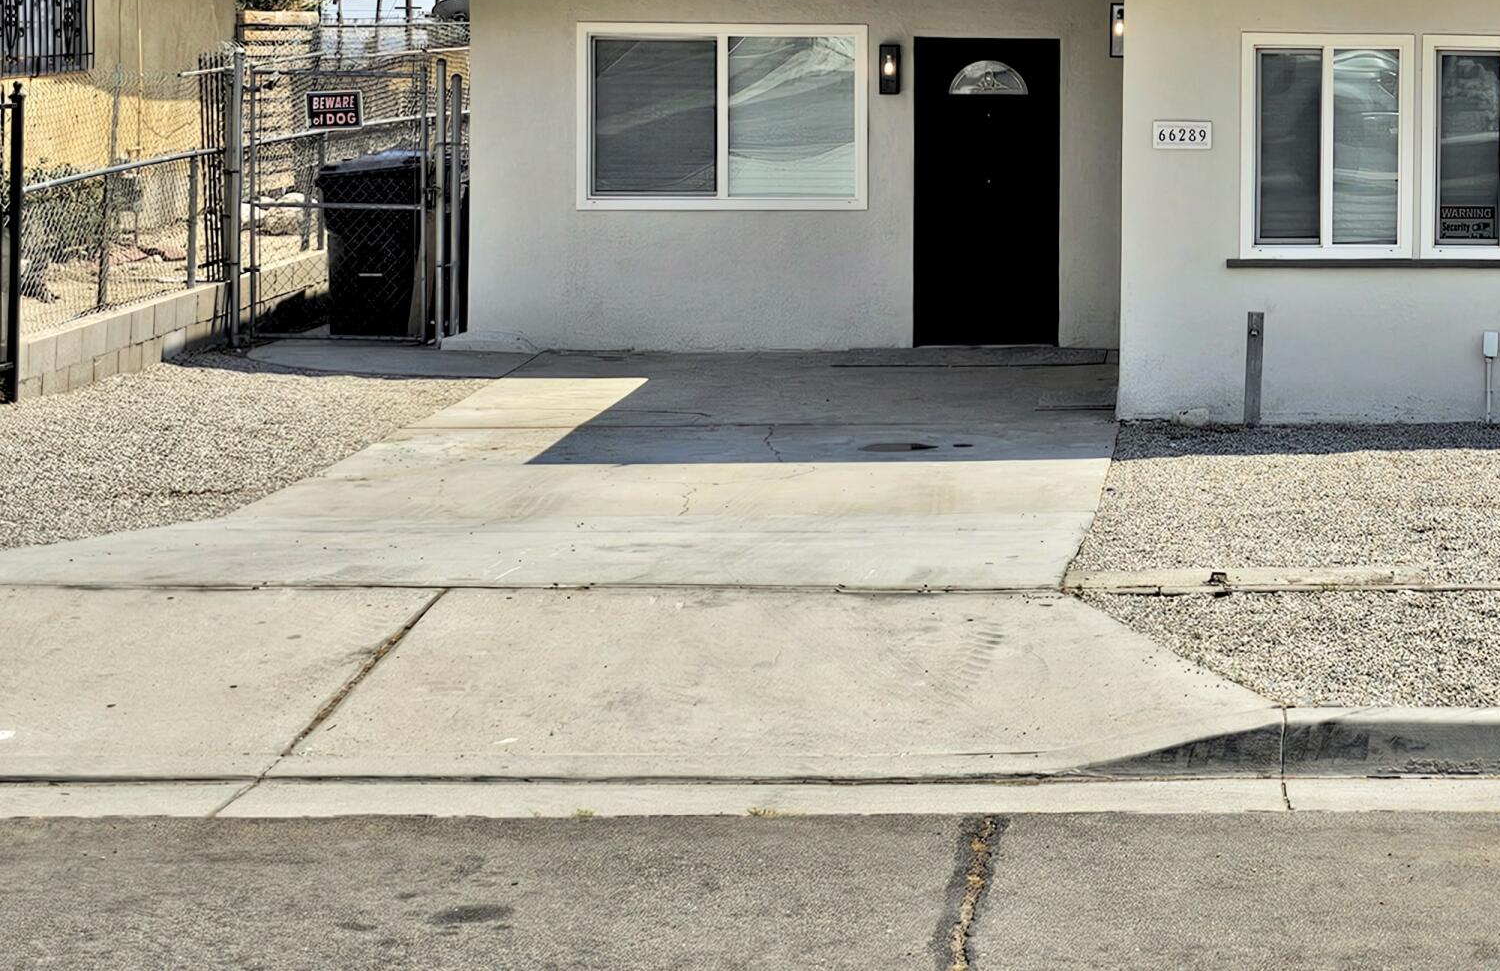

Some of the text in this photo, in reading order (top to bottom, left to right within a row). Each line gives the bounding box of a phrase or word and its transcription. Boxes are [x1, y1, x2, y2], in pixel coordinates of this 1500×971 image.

[312, 96, 355, 109] BEWARE
[326, 113, 356, 125] DOG
[1158, 128, 1206, 142] 66289
[1441, 208, 1491, 218] WARNING
